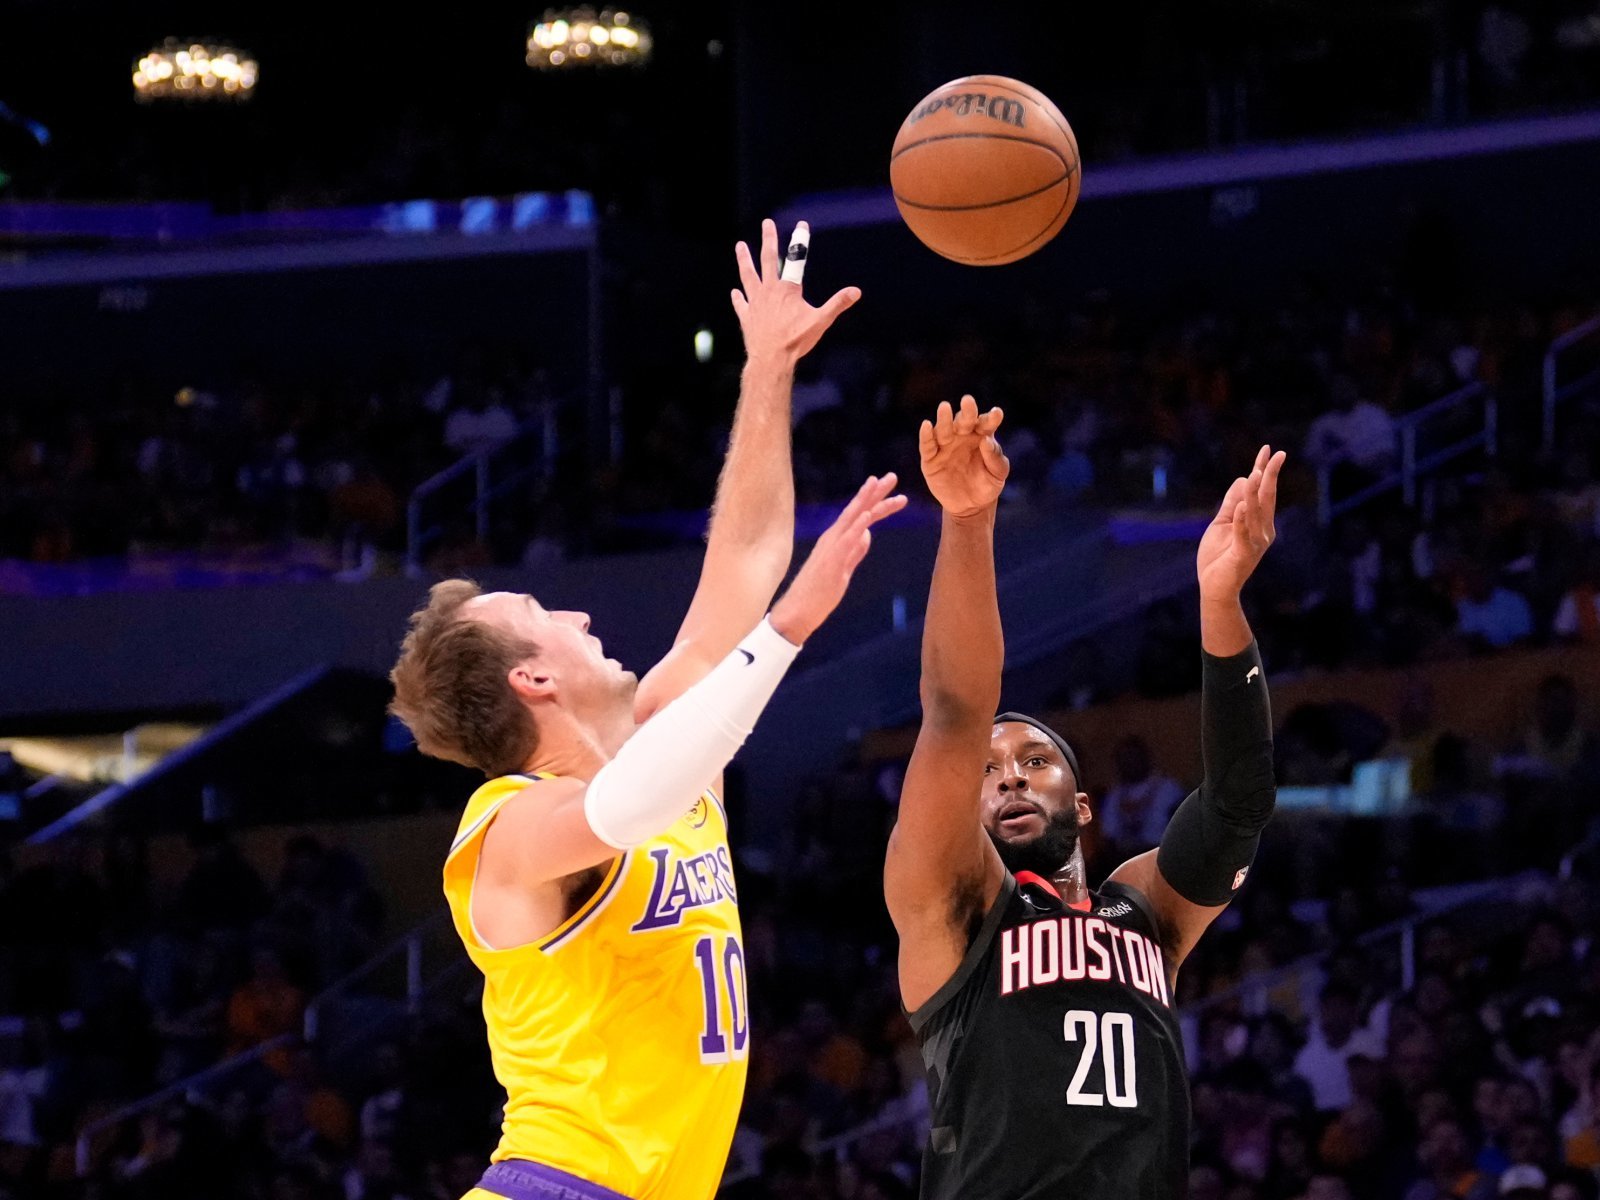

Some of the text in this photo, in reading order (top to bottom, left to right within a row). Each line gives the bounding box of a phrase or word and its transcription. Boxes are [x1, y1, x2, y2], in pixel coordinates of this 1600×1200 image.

[695, 936, 748, 1060] 10
[1000, 917, 1170, 1009] HOUSTON
[1063, 1010, 1138, 1108] 20
